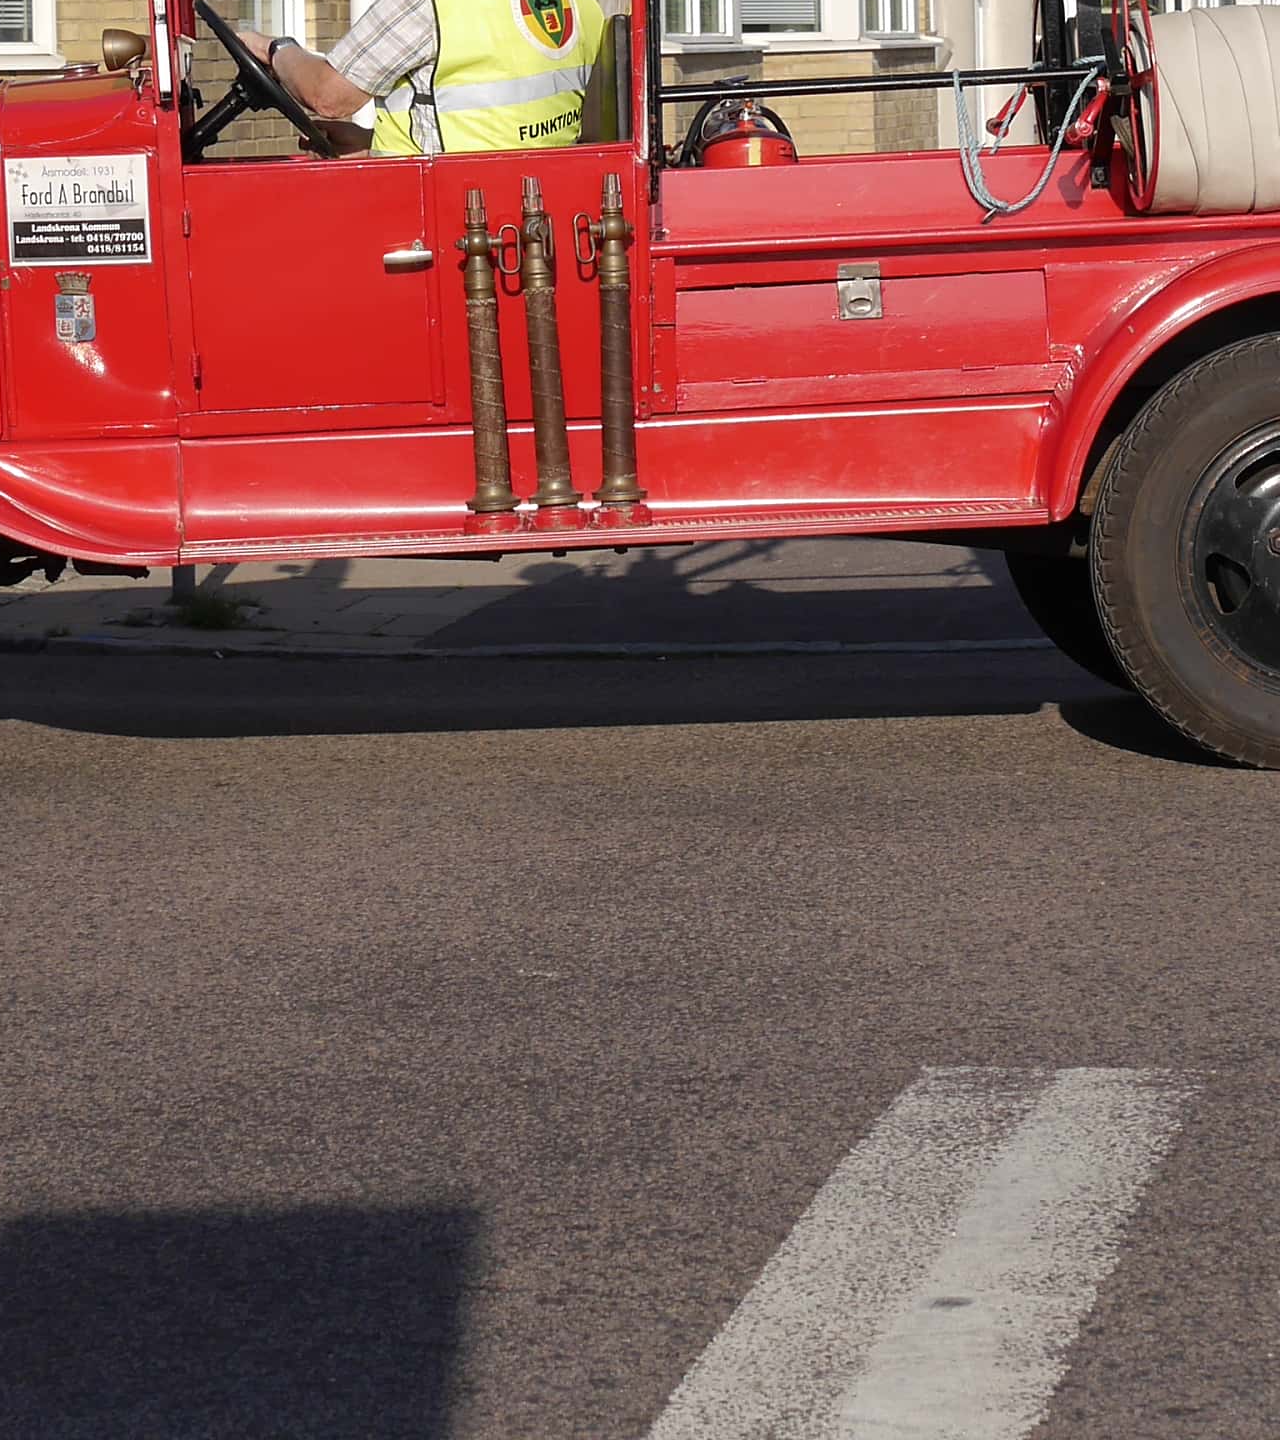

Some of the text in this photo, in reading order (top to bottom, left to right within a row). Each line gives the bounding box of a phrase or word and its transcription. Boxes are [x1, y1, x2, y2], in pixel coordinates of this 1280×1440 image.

[519, 107, 582, 141] FUNKTION
[93, 165, 114, 176] 1931
[22, 179, 135, 205] Ford A Brandbil
[31, 222, 120, 233] Landskrona Kommun
[15, 234, 64, 244] Landskrona
